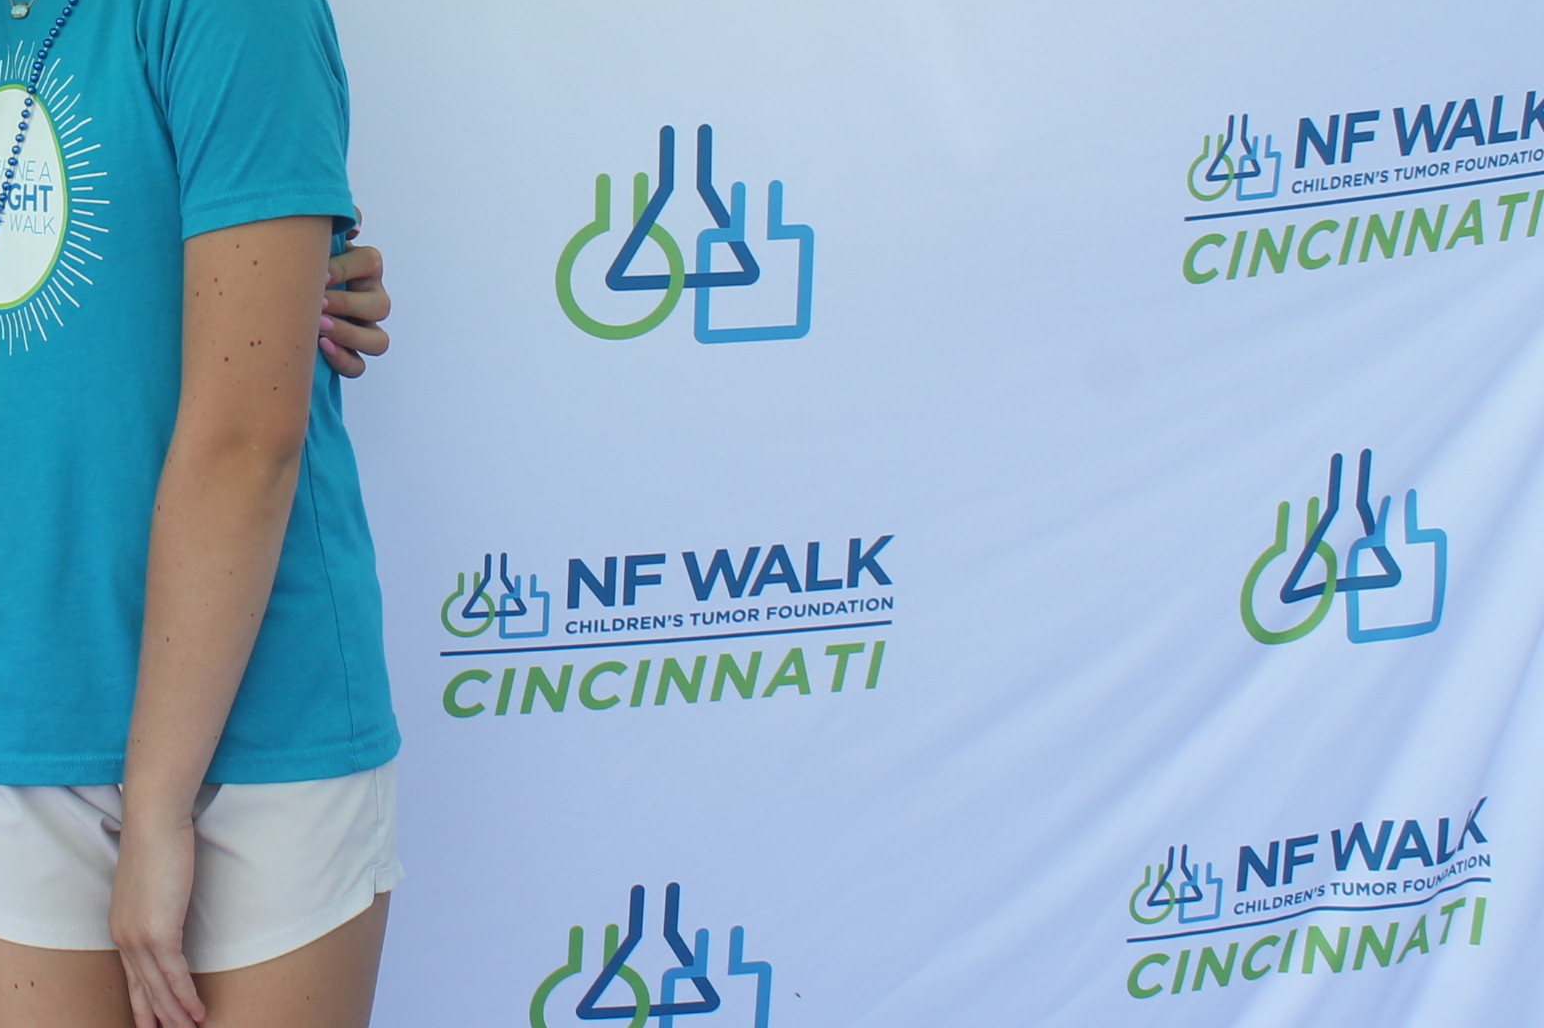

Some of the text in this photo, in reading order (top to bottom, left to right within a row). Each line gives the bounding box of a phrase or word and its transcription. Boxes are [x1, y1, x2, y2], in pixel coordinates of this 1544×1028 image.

[1295, 110, 1380, 169] NF
[39, 161, 52, 182] A
[1291, 148, 1544, 194] CHILDREN'S TUMOR FOUNDATIO
[10, 213, 56, 236] WALK
[1182, 188, 1544, 285] CINCINNATI
[567, 534, 895, 609] NF WALK
[564, 596, 894, 635] CHILDREN'S TUMOR FOUNDATION
[442, 640, 886, 719] CINCINNATI
[1236, 796, 1489, 892] NF WALK
[1233, 884, 1325, 915] CHILDREN'S
[1330, 880, 1397, 897] TUMOR
[1126, 897, 1487, 999] CINCINNATI
